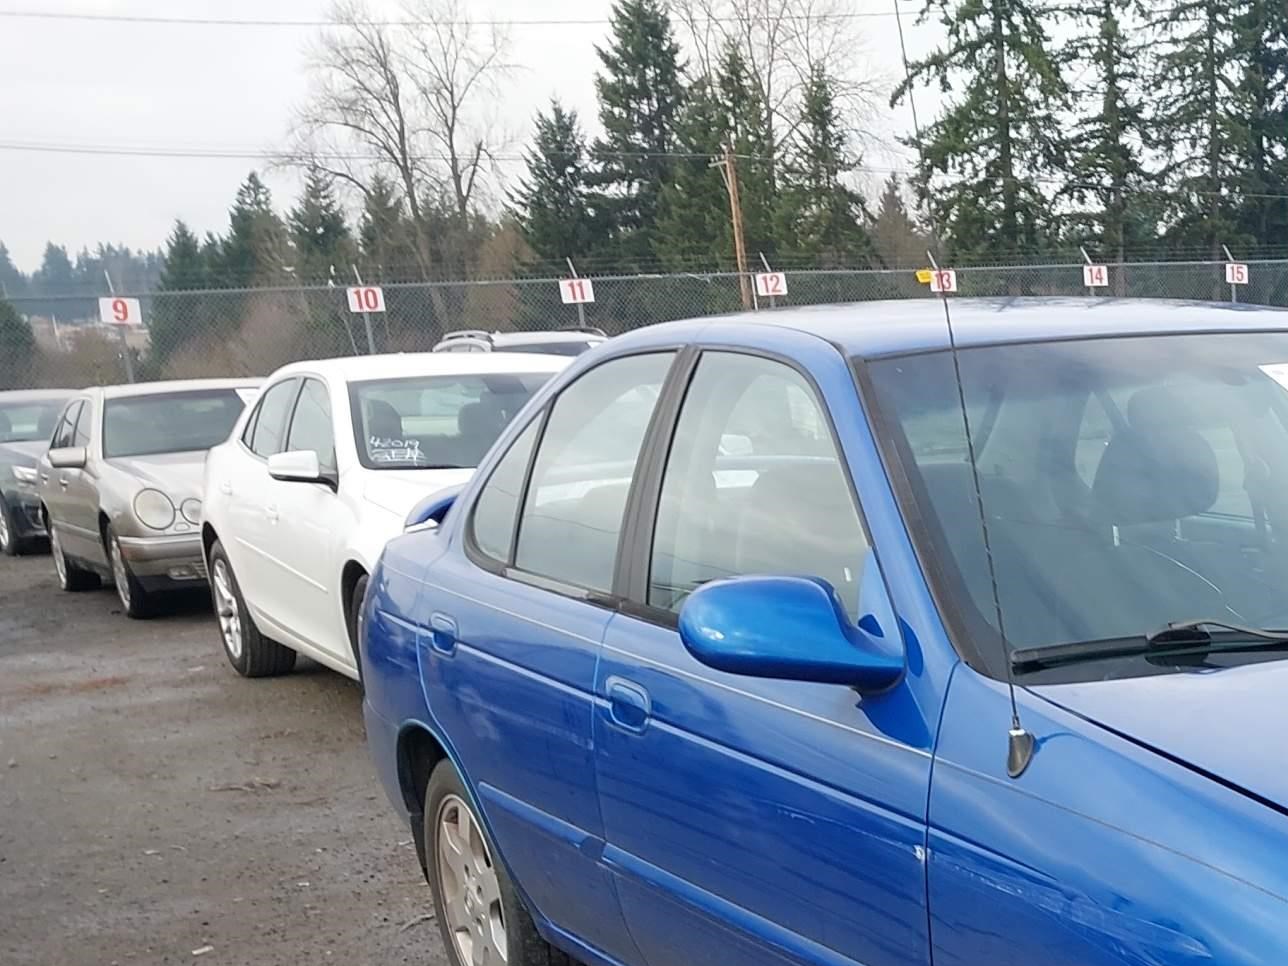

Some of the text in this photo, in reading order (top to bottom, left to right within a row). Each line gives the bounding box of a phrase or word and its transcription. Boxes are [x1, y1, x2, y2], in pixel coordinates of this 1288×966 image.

[934, 271, 951, 290] 13
[1088, 267, 1104, 284] 14
[1229, 265, 1244, 281] 15
[567, 281, 586, 301] 11
[761, 274, 782, 294] 12
[353, 289, 380, 310] 10
[112, 300, 129, 322] 9
